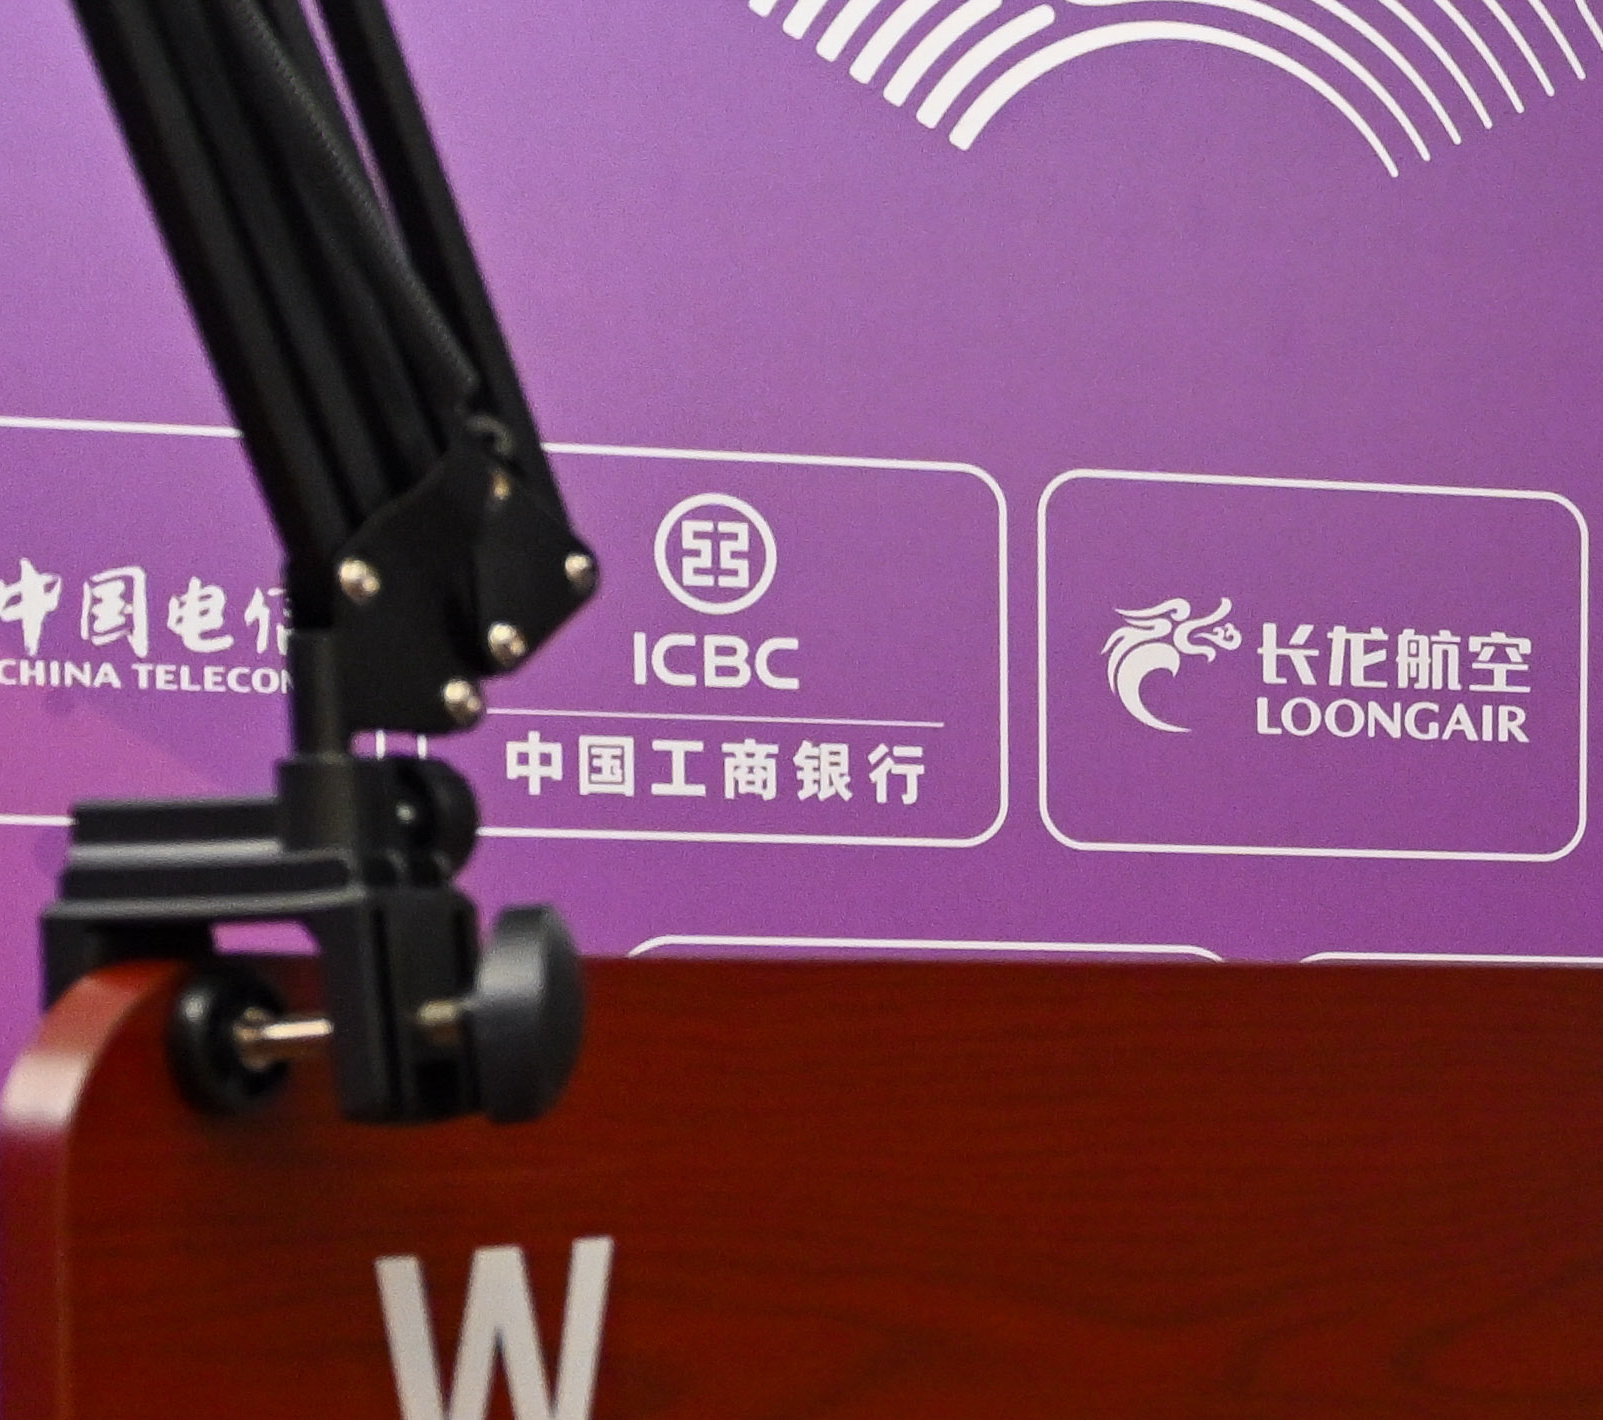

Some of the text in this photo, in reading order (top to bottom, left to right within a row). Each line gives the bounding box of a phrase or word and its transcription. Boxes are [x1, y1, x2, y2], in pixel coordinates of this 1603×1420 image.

[632, 630, 800, 690] ICBC
[1257, 622, 1532, 694] 长龙航空
[1256, 696, 1530, 743] LOONGAIR
[505, 730, 926, 805] 中国工商银行
